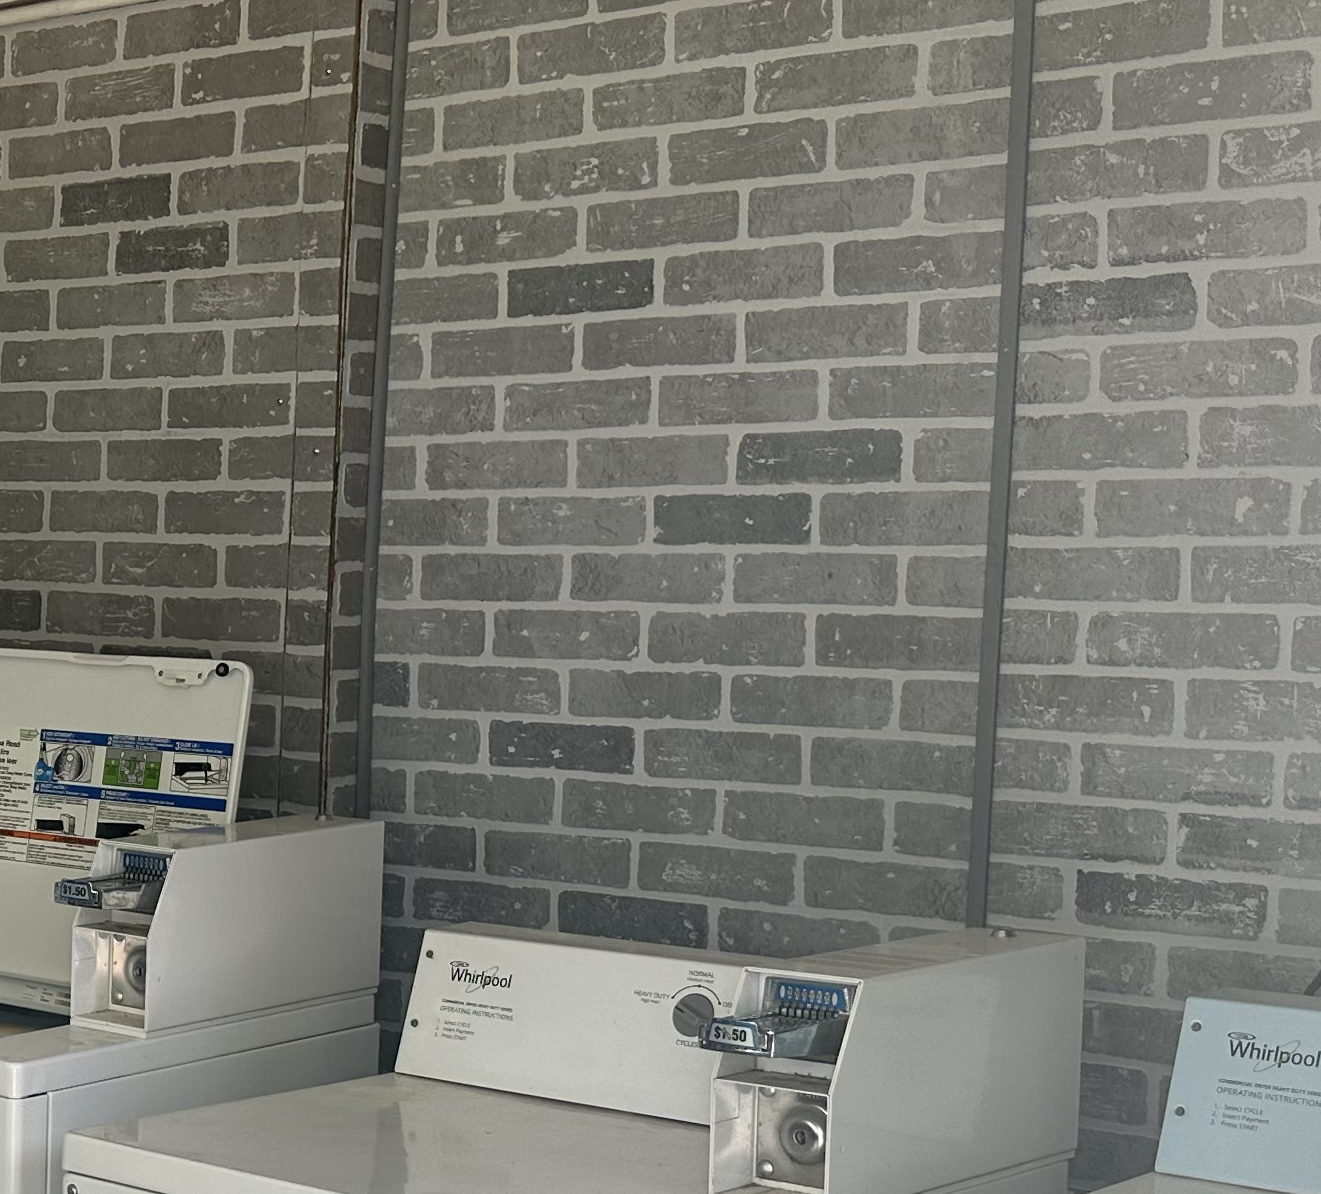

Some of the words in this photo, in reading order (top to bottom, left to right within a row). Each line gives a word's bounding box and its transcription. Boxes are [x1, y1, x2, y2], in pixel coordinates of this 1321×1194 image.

[62, 885, 87, 898] $1.50
[450, 965, 513, 989] Whirlpool
[1229, 1039, 1321, 1068] Whirlpool
[1216, 1086, 1263, 1100] OPERATING
[1264, 1094, 1321, 1108] INSTRUCTION
